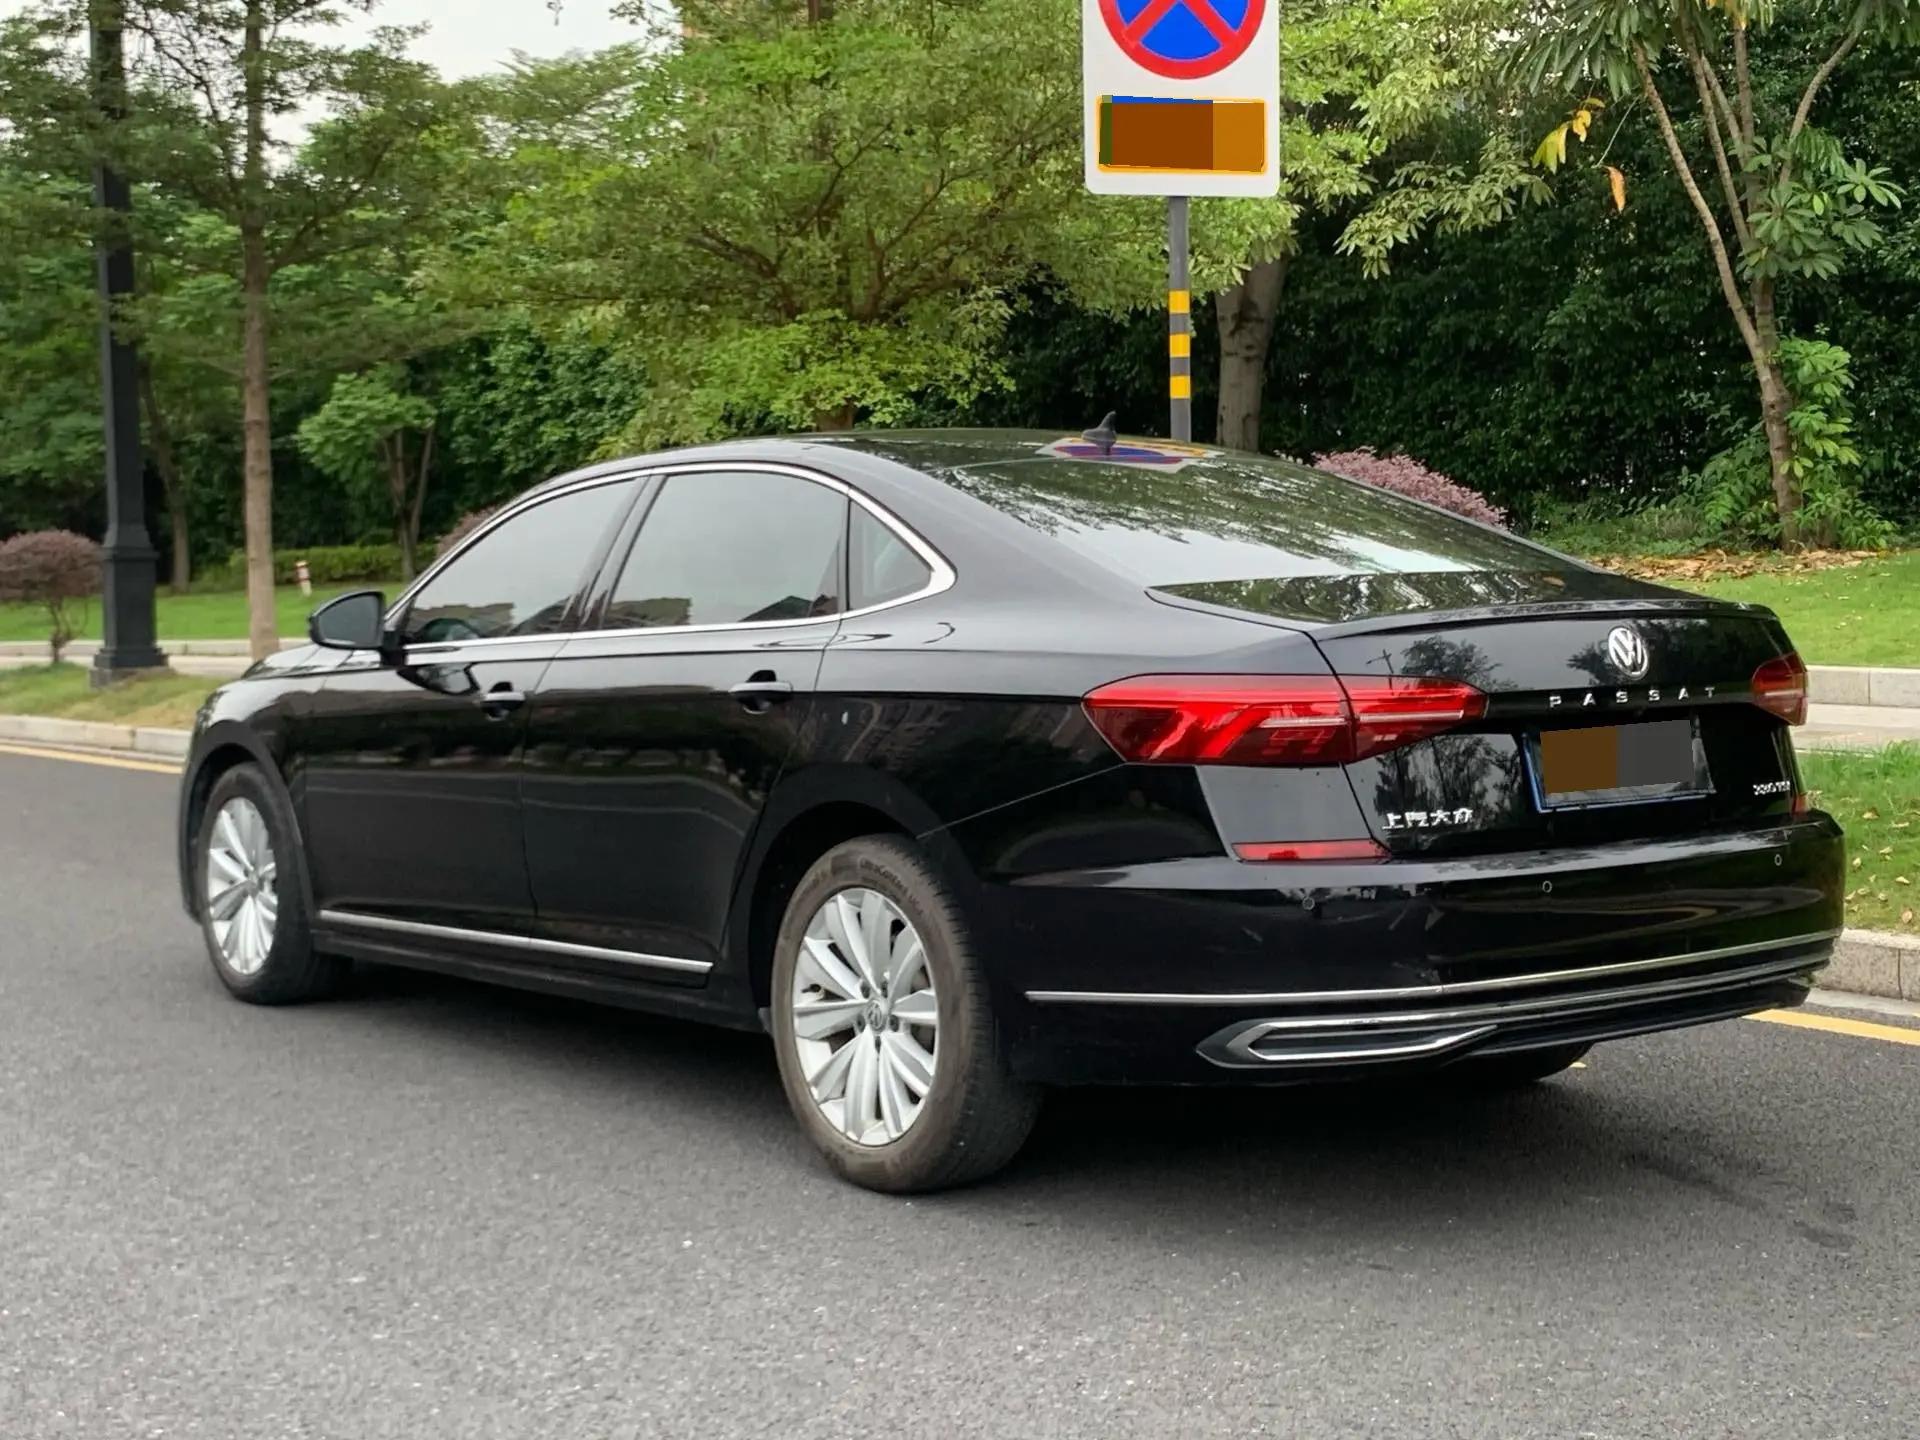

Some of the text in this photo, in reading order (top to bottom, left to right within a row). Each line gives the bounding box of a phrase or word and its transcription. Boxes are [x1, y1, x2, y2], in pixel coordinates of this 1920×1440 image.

[1549, 686, 1716, 708] PASSAT
[1381, 807, 1473, 830] 上汽大众
